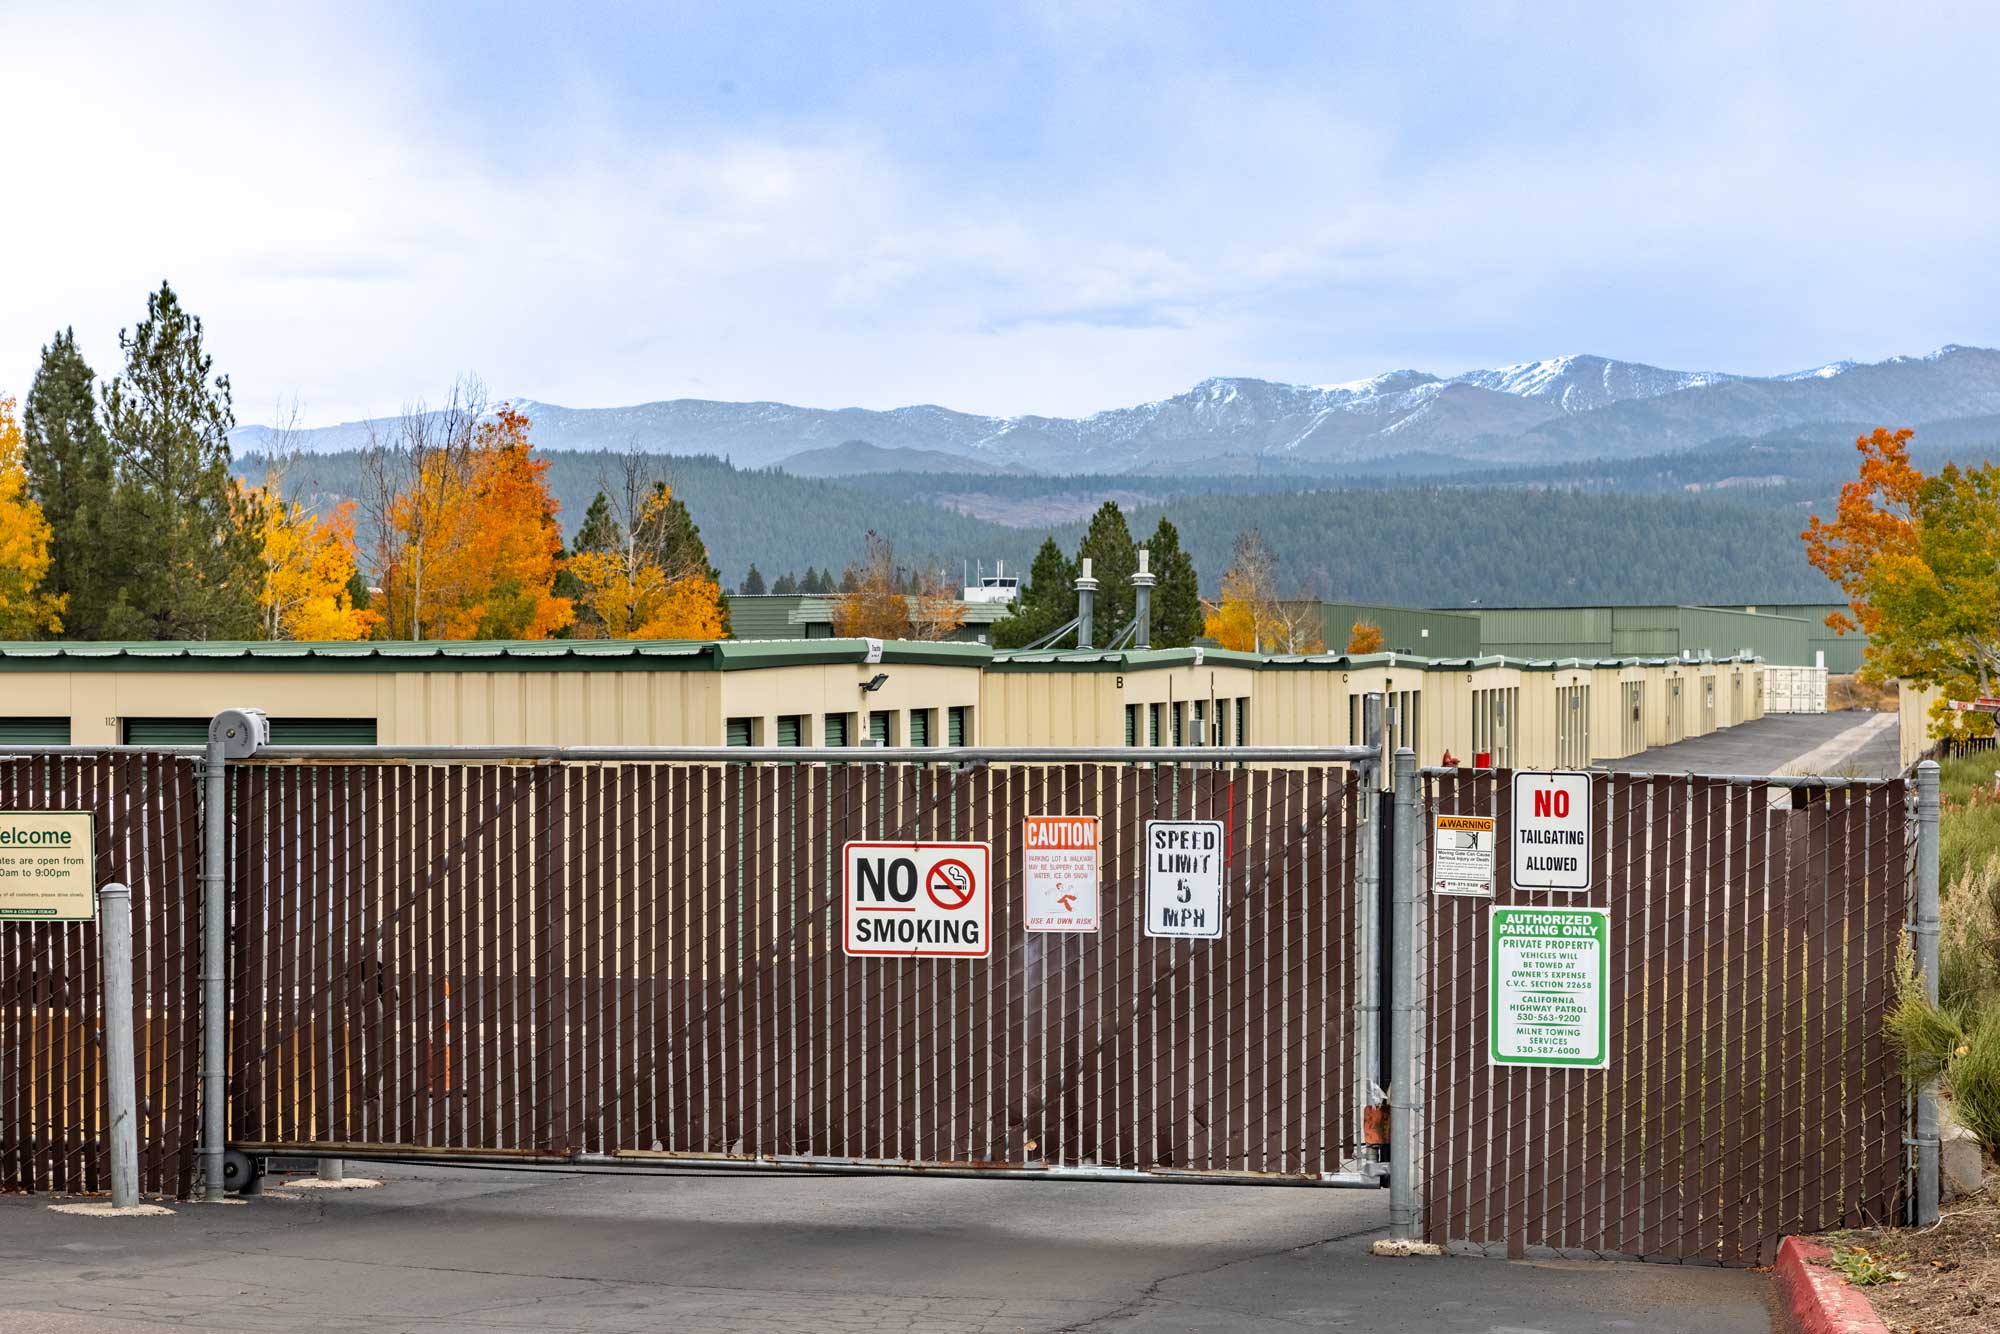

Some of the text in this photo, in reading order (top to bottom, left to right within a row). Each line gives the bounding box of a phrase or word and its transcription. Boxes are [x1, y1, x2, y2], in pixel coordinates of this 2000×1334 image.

[1116, 677, 1124, 688] B
[1342, 674, 1348, 683] C
[1467, 675, 1472, 683] D
[105, 717, 116, 726] 112
[1535, 790, 1569, 818] NO
[1448, 820, 1491, 830] WARNING
[0, 827, 71, 844] elcome
[1028, 822, 1094, 846] CAUTION
[1520, 830, 1584, 845] TAILGATING
[1155, 830, 1214, 850] SPEED
[1158, 854, 1211, 874] LIMIT
[1526, 856, 1577, 872] ALLOWED
[23, 869, 31, 877] to
[35, 869, 70, 878] 9:00pm
[857, 858, 918, 902] NO
[1177, 878, 1191, 903] 5
[1031, 917, 1093, 925] USE AT OWN RISK
[1163, 907, 1205, 927] MPH
[1506, 914, 1592, 926] AUTHORIZED
[856, 918, 979, 944] SMOKING
[1500, 924, 1599, 936] PARKING ONLY
[1503, 940, 1594, 950] PRIVATE PROPERTY
[1522, 996, 1575, 1004] CALIFORNIA
[1555, 1005, 1587, 1013] PATROL
[1517, 1014, 1580, 1022] 530-563-9200
[1546, 1029, 1581, 1037] TOWING
[1517, 1046, 1580, 1055] 530-587-6000
